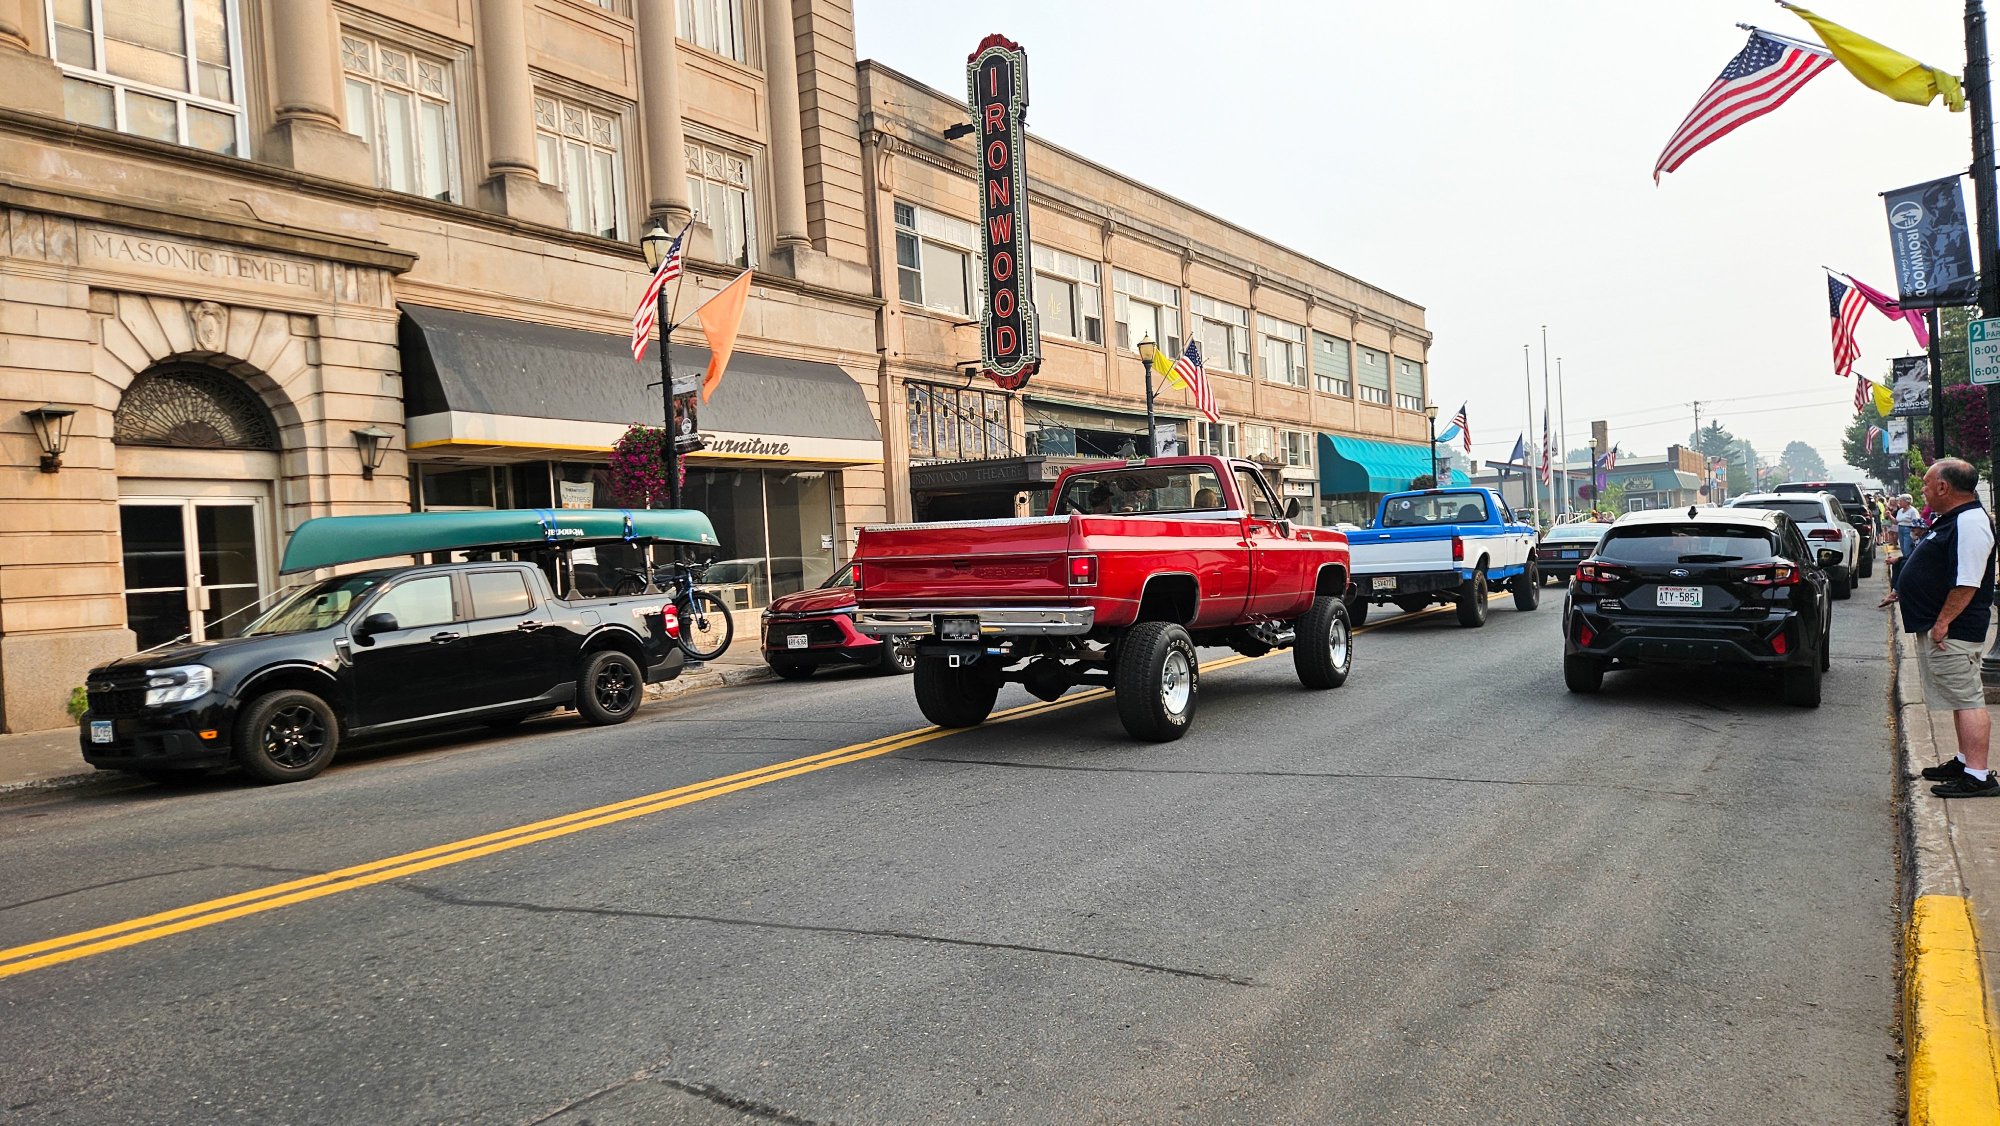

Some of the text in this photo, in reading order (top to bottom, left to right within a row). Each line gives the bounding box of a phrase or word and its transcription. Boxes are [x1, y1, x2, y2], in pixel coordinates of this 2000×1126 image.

[985, 66, 1017, 356] IRONWOOD
[92, 234, 311, 287] MASONIC TEMPLE
[1906, 228, 1928, 297] IRONWOOD
[1972, 324, 1982, 340] 2
[1974, 344, 1998, 355] 8:00
[1974, 366, 1999, 376] 6:00
[699, 433, 790, 455] Furniture
[913, 465, 1024, 484] IRONWOOD THEATRE
[1659, 592, 1699, 602] ATY-5851
